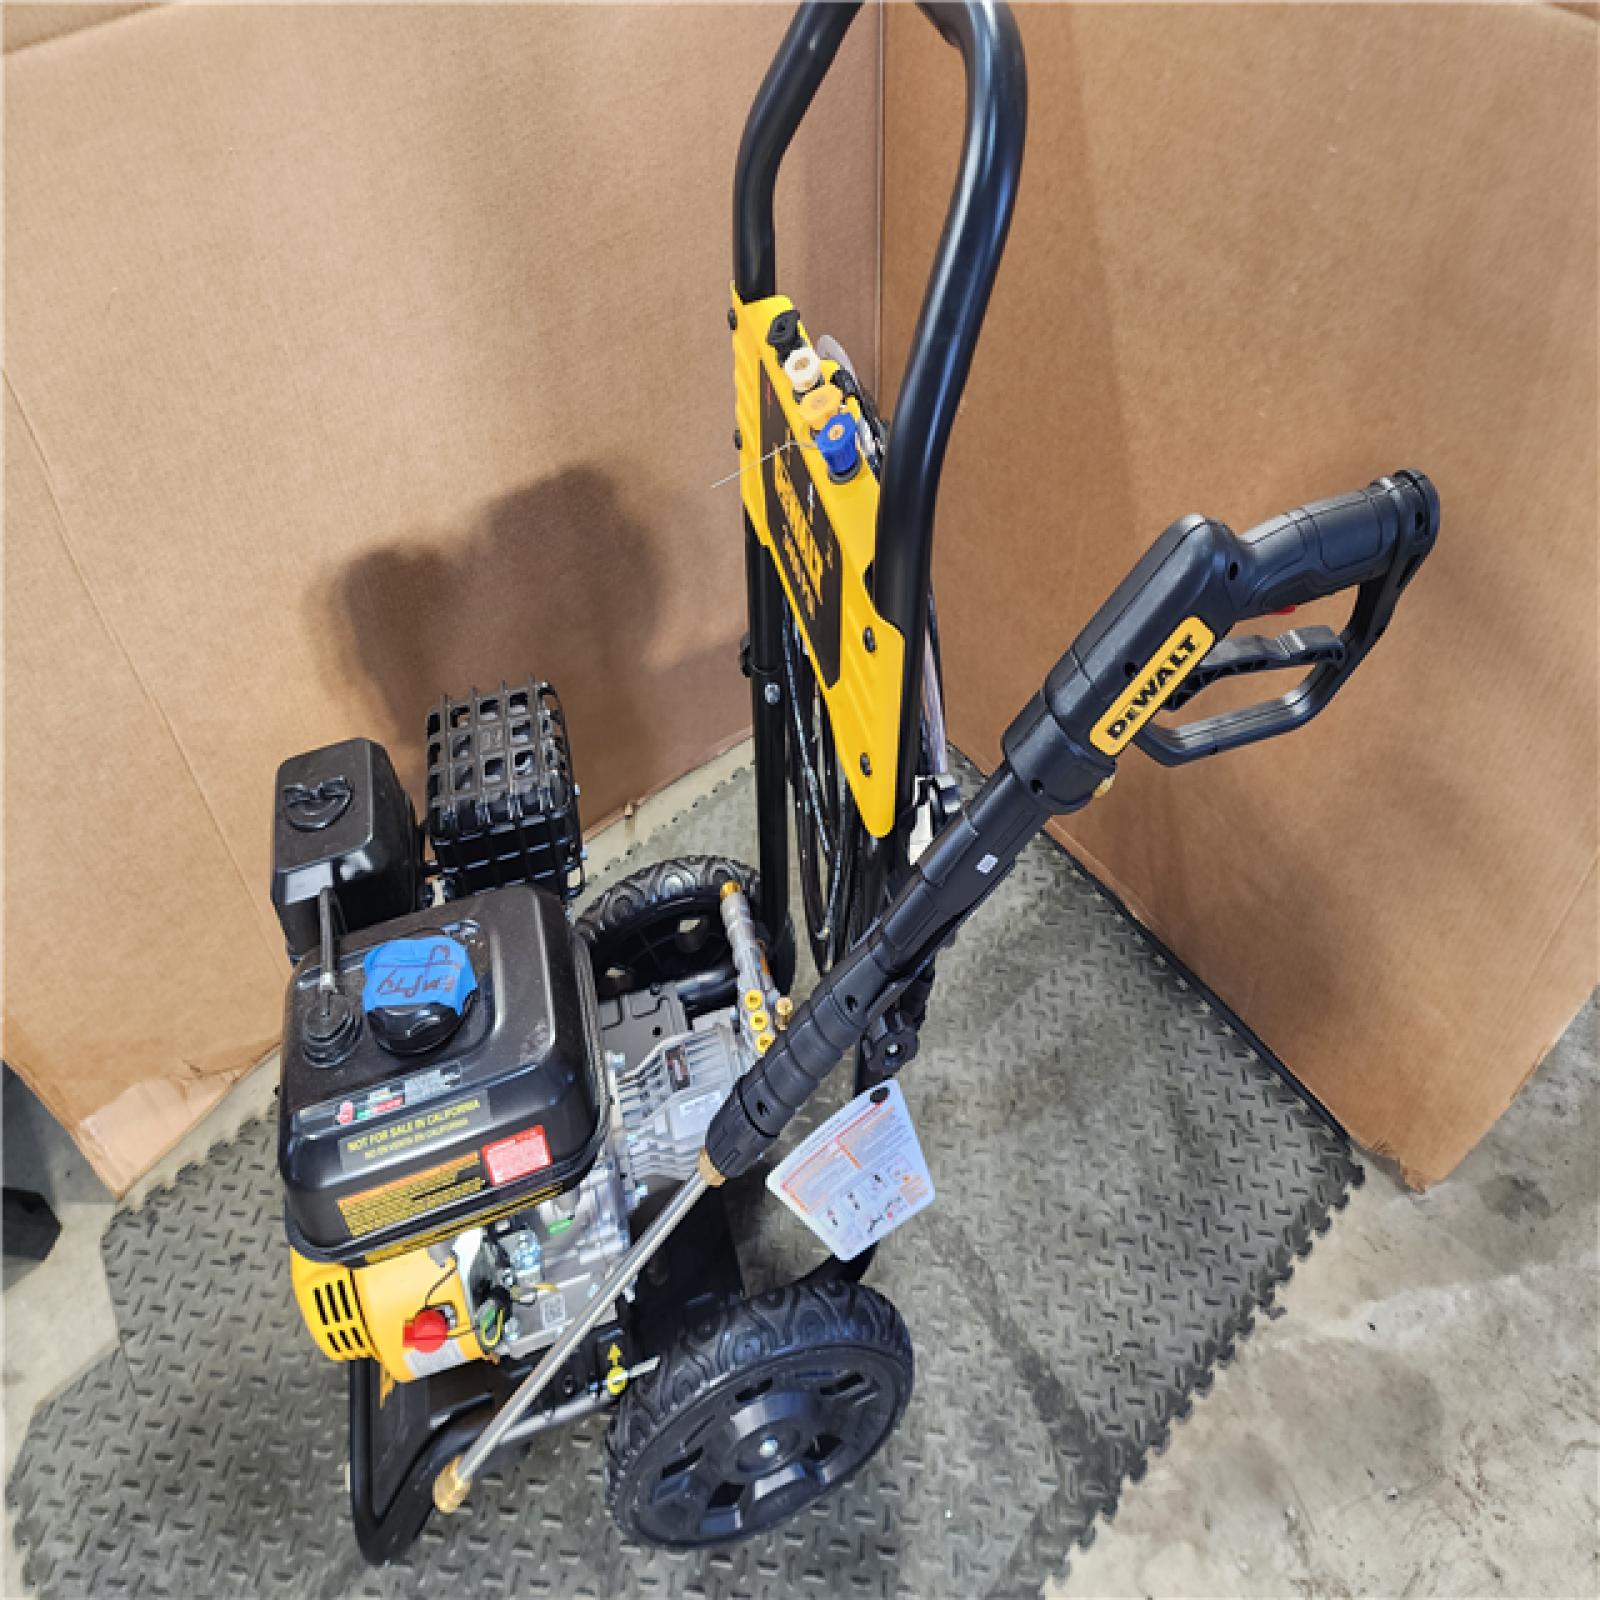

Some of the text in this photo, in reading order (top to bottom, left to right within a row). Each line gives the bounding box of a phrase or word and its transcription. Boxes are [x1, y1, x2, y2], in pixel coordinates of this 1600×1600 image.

[1106, 633, 1197, 741] DEWALT
[347, 1099, 481, 1152] NOT FOR SALE IN CALIFORNIA
